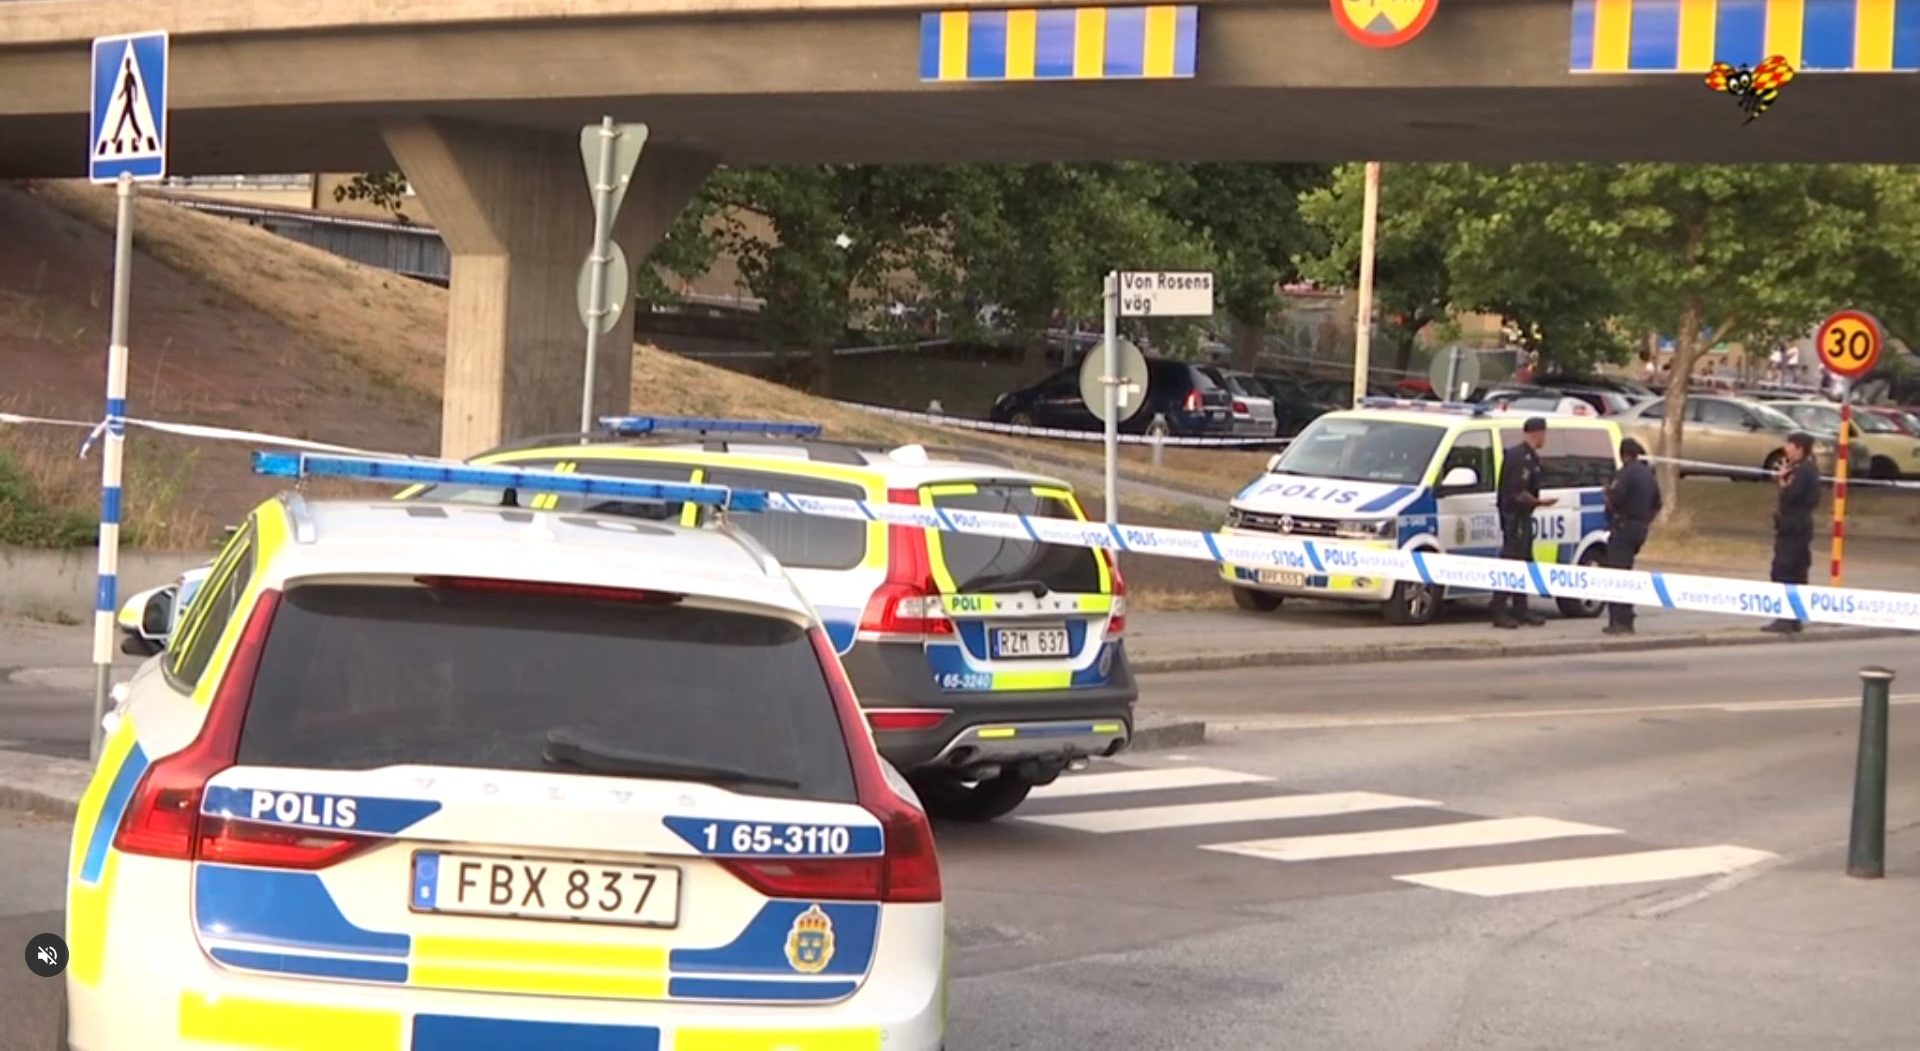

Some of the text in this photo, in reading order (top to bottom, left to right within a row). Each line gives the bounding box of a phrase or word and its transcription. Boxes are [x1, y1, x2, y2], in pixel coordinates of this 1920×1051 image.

[1124, 272, 1210, 289] Von Rosens
[1124, 294, 1152, 313] väg
[1828, 328, 1870, 361] 30
[1257, 483, 1359, 503] POLIS
[1528, 515, 1565, 539] OLIS
[1126, 529, 1157, 547] POLIS
[1271, 549, 1305, 569] POLIS
[1323, 548, 1358, 567] POLIS
[1488, 570, 1526, 590] POLIS
[1549, 568, 1588, 589] POLIS
[952, 597, 982, 611] POLI
[1739, 592, 1782, 615] POLIS
[1810, 591, 1855, 614] POLIS
[1001, 632, 1065, 653] RZM 637
[943, 673, 991, 688] 65-3240
[251, 790, 357, 828] POLIS
[703, 823, 849, 854] 1 65-3110
[458, 862, 657, 914] FBX 837
